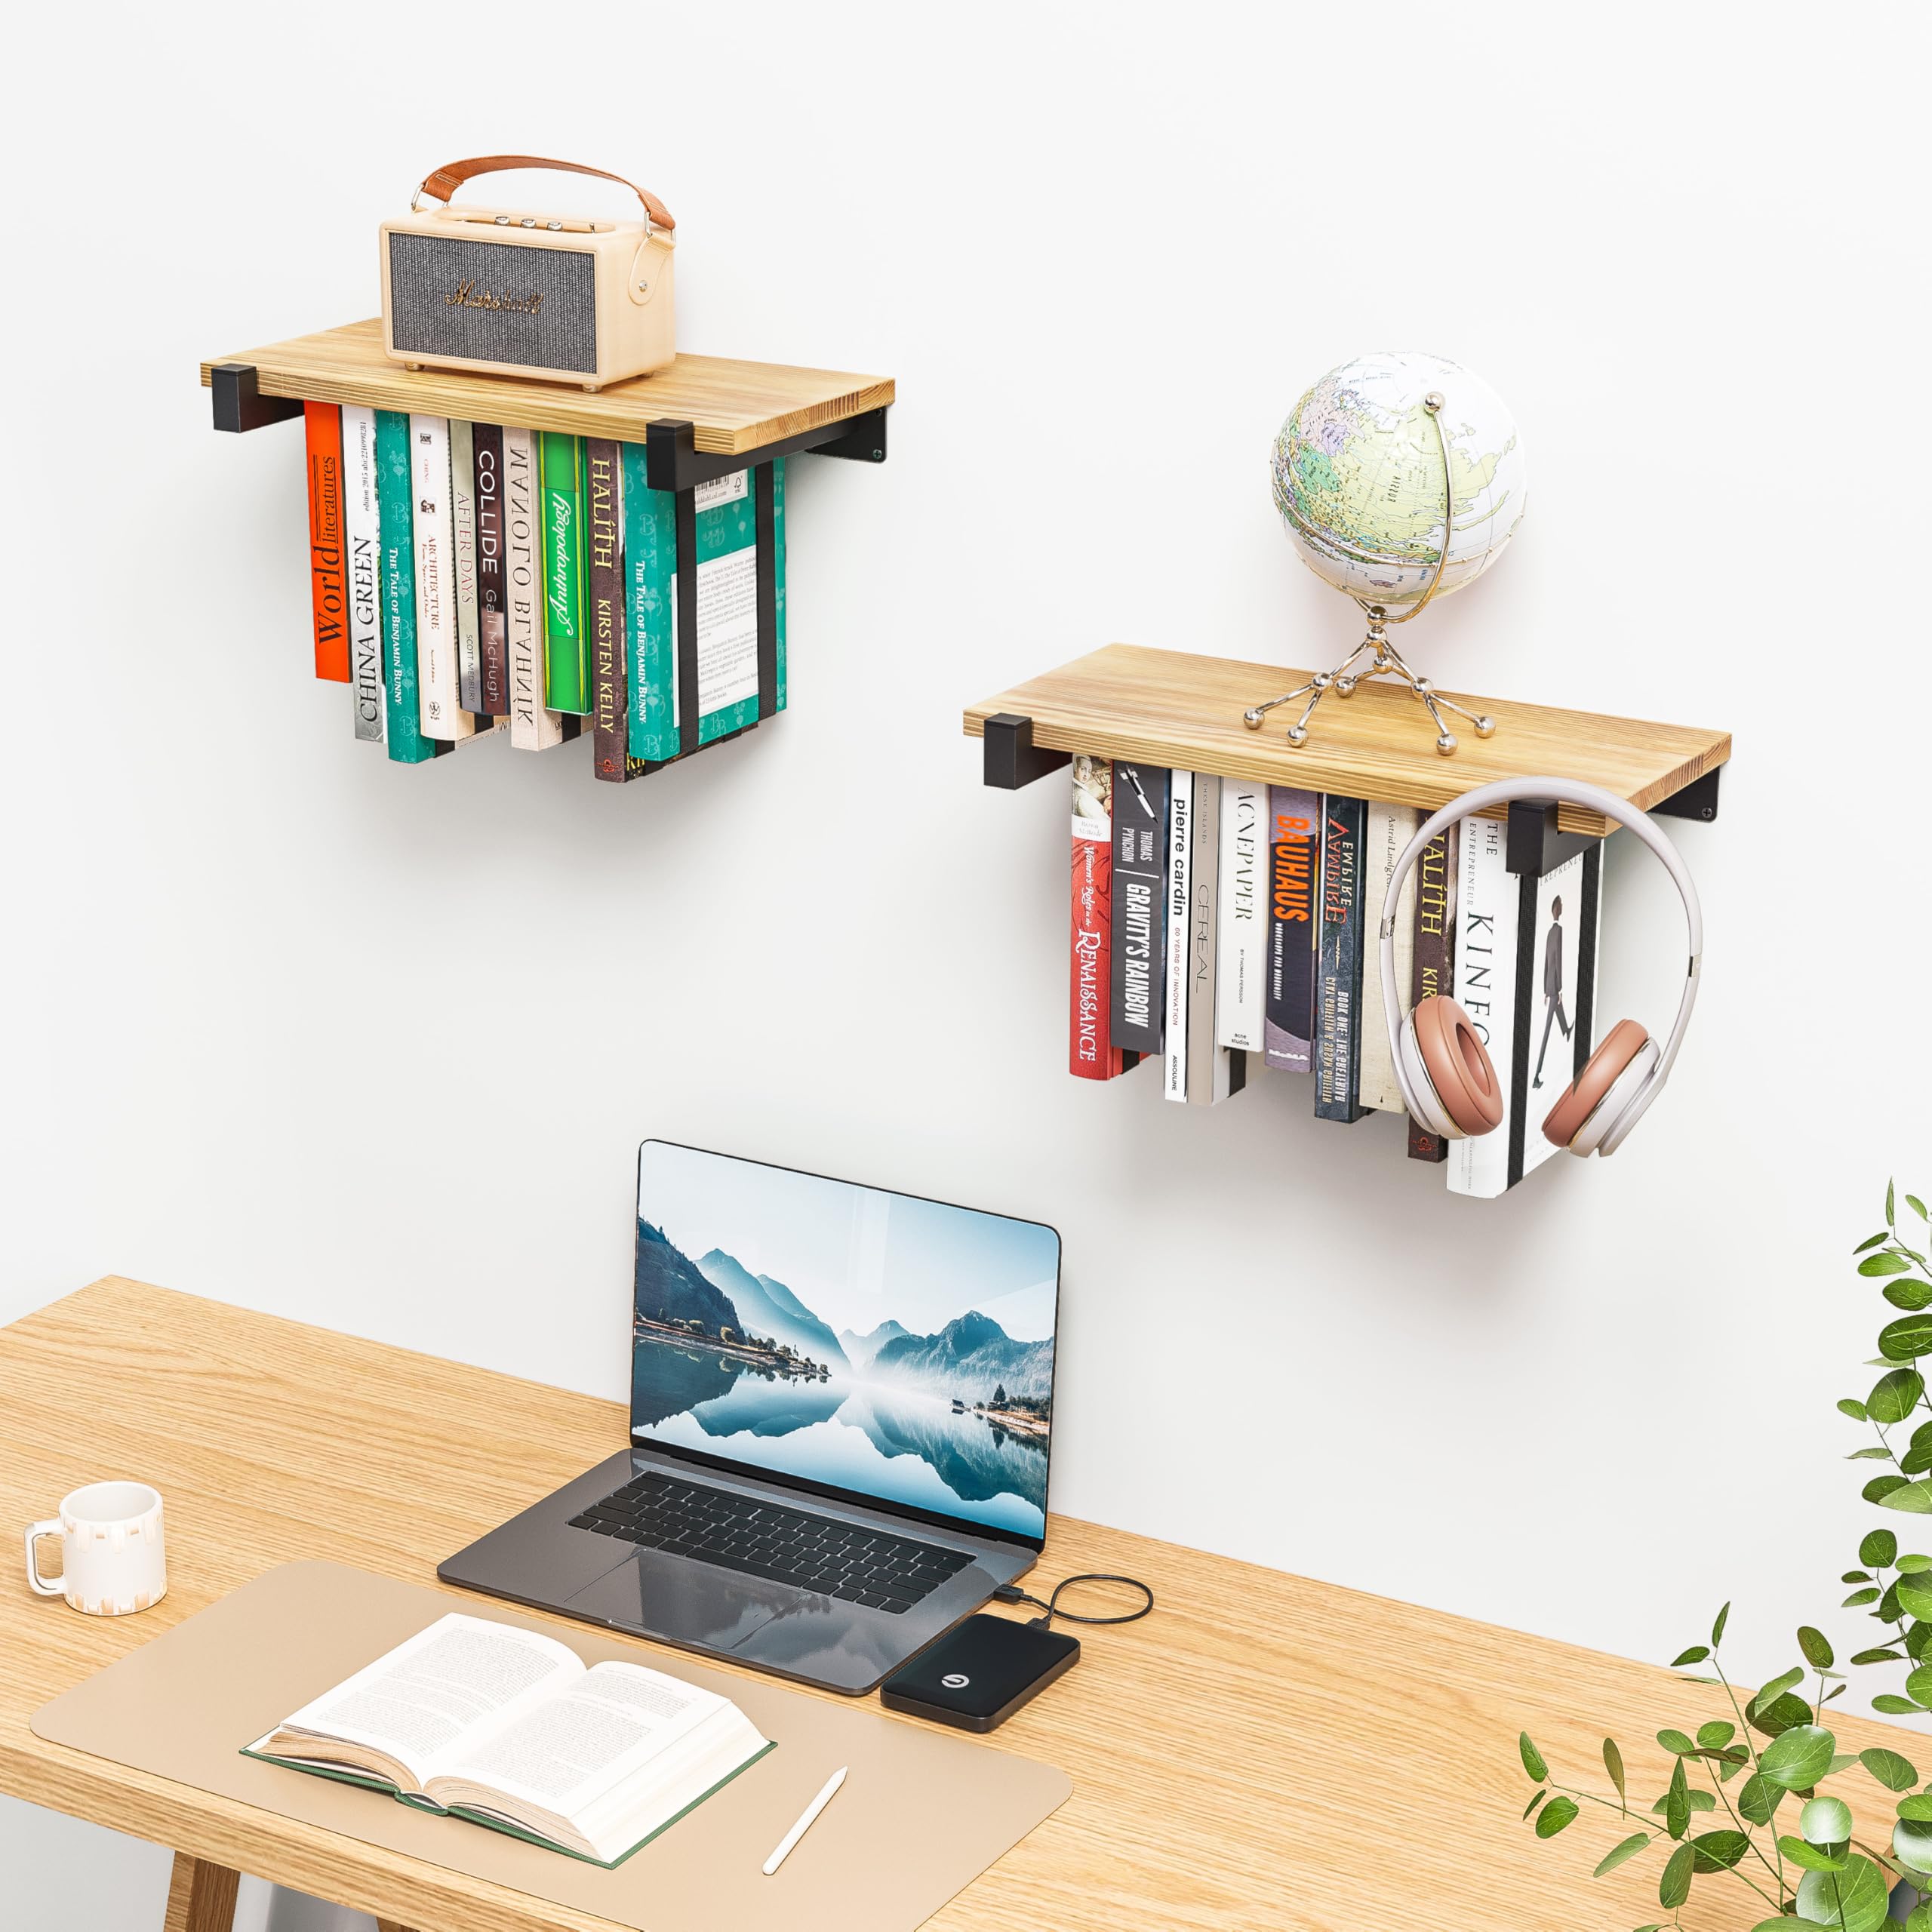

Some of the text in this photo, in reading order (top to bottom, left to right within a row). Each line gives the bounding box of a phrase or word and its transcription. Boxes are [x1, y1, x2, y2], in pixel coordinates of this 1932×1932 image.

[444, 278, 544, 315] Marshall
[312, 456, 343, 645] World literatures
[457, 492, 474, 604] AFTER DAYS
[478, 451, 497, 574] COLLIDE
[548, 492, 574, 636] Anthropology
[353, 536, 377, 722] CHINA GREEN
[389, 547, 402, 706] THE TALE OF BENJAMIN BUNNY
[428, 534, 439, 631] ARCHITECTURE
[485, 589, 500, 703] Gail McHugh
[598, 598, 614, 734] KIRSTEN KELLY
[635, 561, 648, 724] THE TALE OF BENJAMIN BUNNY
[1083, 846, 1094, 883] Women's
[1121, 827, 1134, 863] PYNCHON
[1140, 831, 1153, 862] THOMAS
[1173, 798, 1188, 916] pierre cardin
[1235, 786, 1255, 920] ACNEPAPER
[1273, 814, 1311, 922] BAUHAUS
[1466, 823, 1477, 906] ENTREPRENEUR
[1486, 823, 1499, 856] THE
[1081, 885, 1095, 910] Roles
[1174, 927, 1180, 937] 60
[1195, 884, 1210, 994] CEREAL
[1124, 883, 1151, 1028] GRAVITY'S RAINBOW
[1174, 967, 1180, 977] OF
[1422, 967, 1438, 1003] KIR
